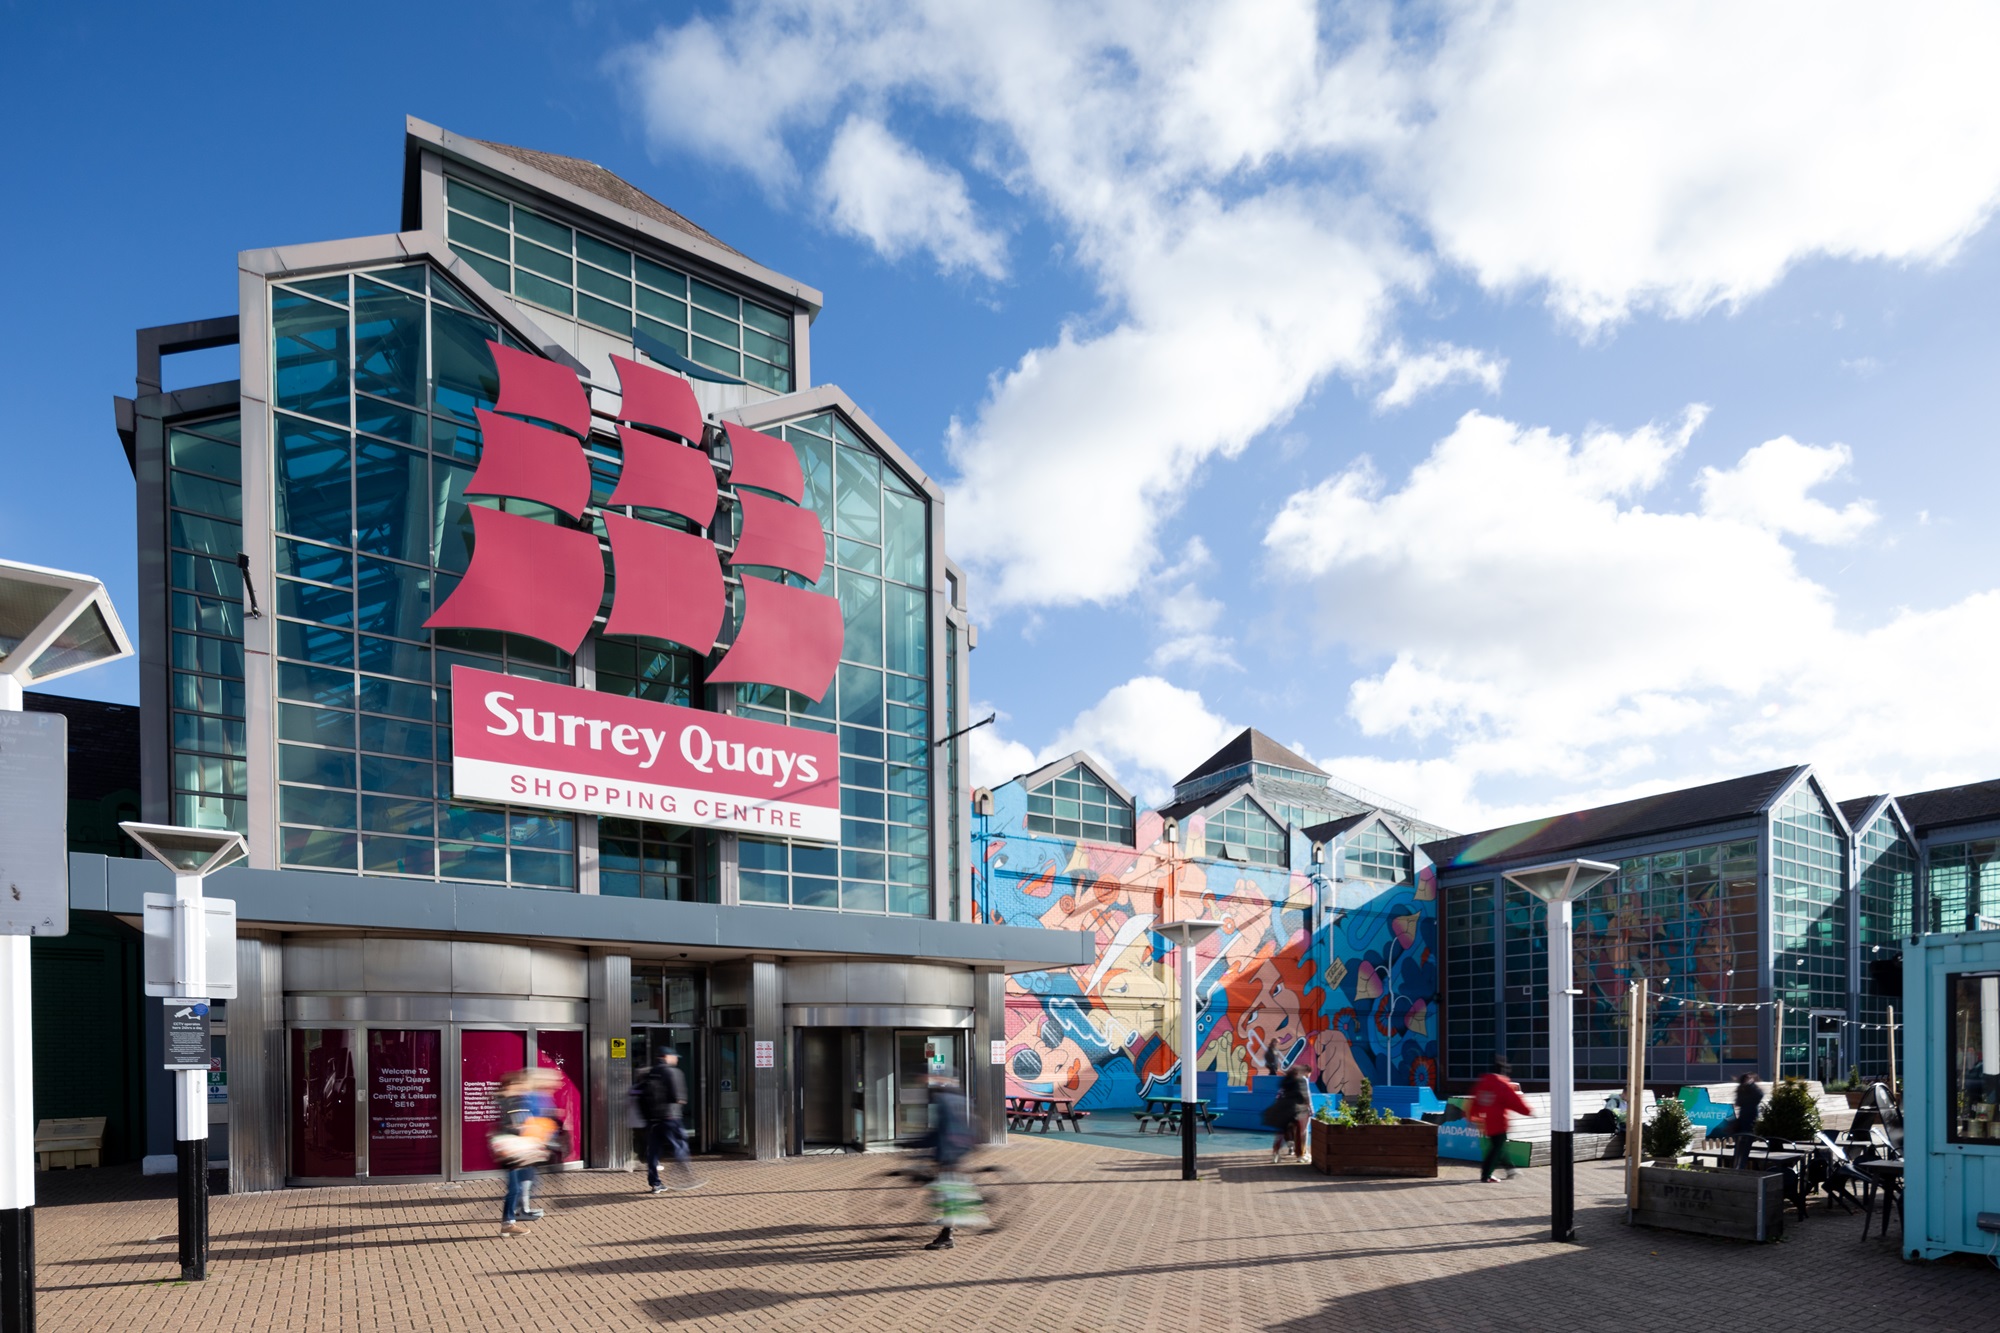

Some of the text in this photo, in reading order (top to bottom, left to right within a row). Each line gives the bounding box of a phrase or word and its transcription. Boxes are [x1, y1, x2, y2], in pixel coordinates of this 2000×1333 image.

[483, 690, 820, 788] Surrey Quays
[510, 773, 803, 829] SHOPPING CENTRE
[386, 1084, 424, 1092] Shopping
[1698, 1111, 1728, 1120] WATER
[1438, 1126, 1464, 1136] NADA
[1664, 1185, 1714, 1201] PIZZA
